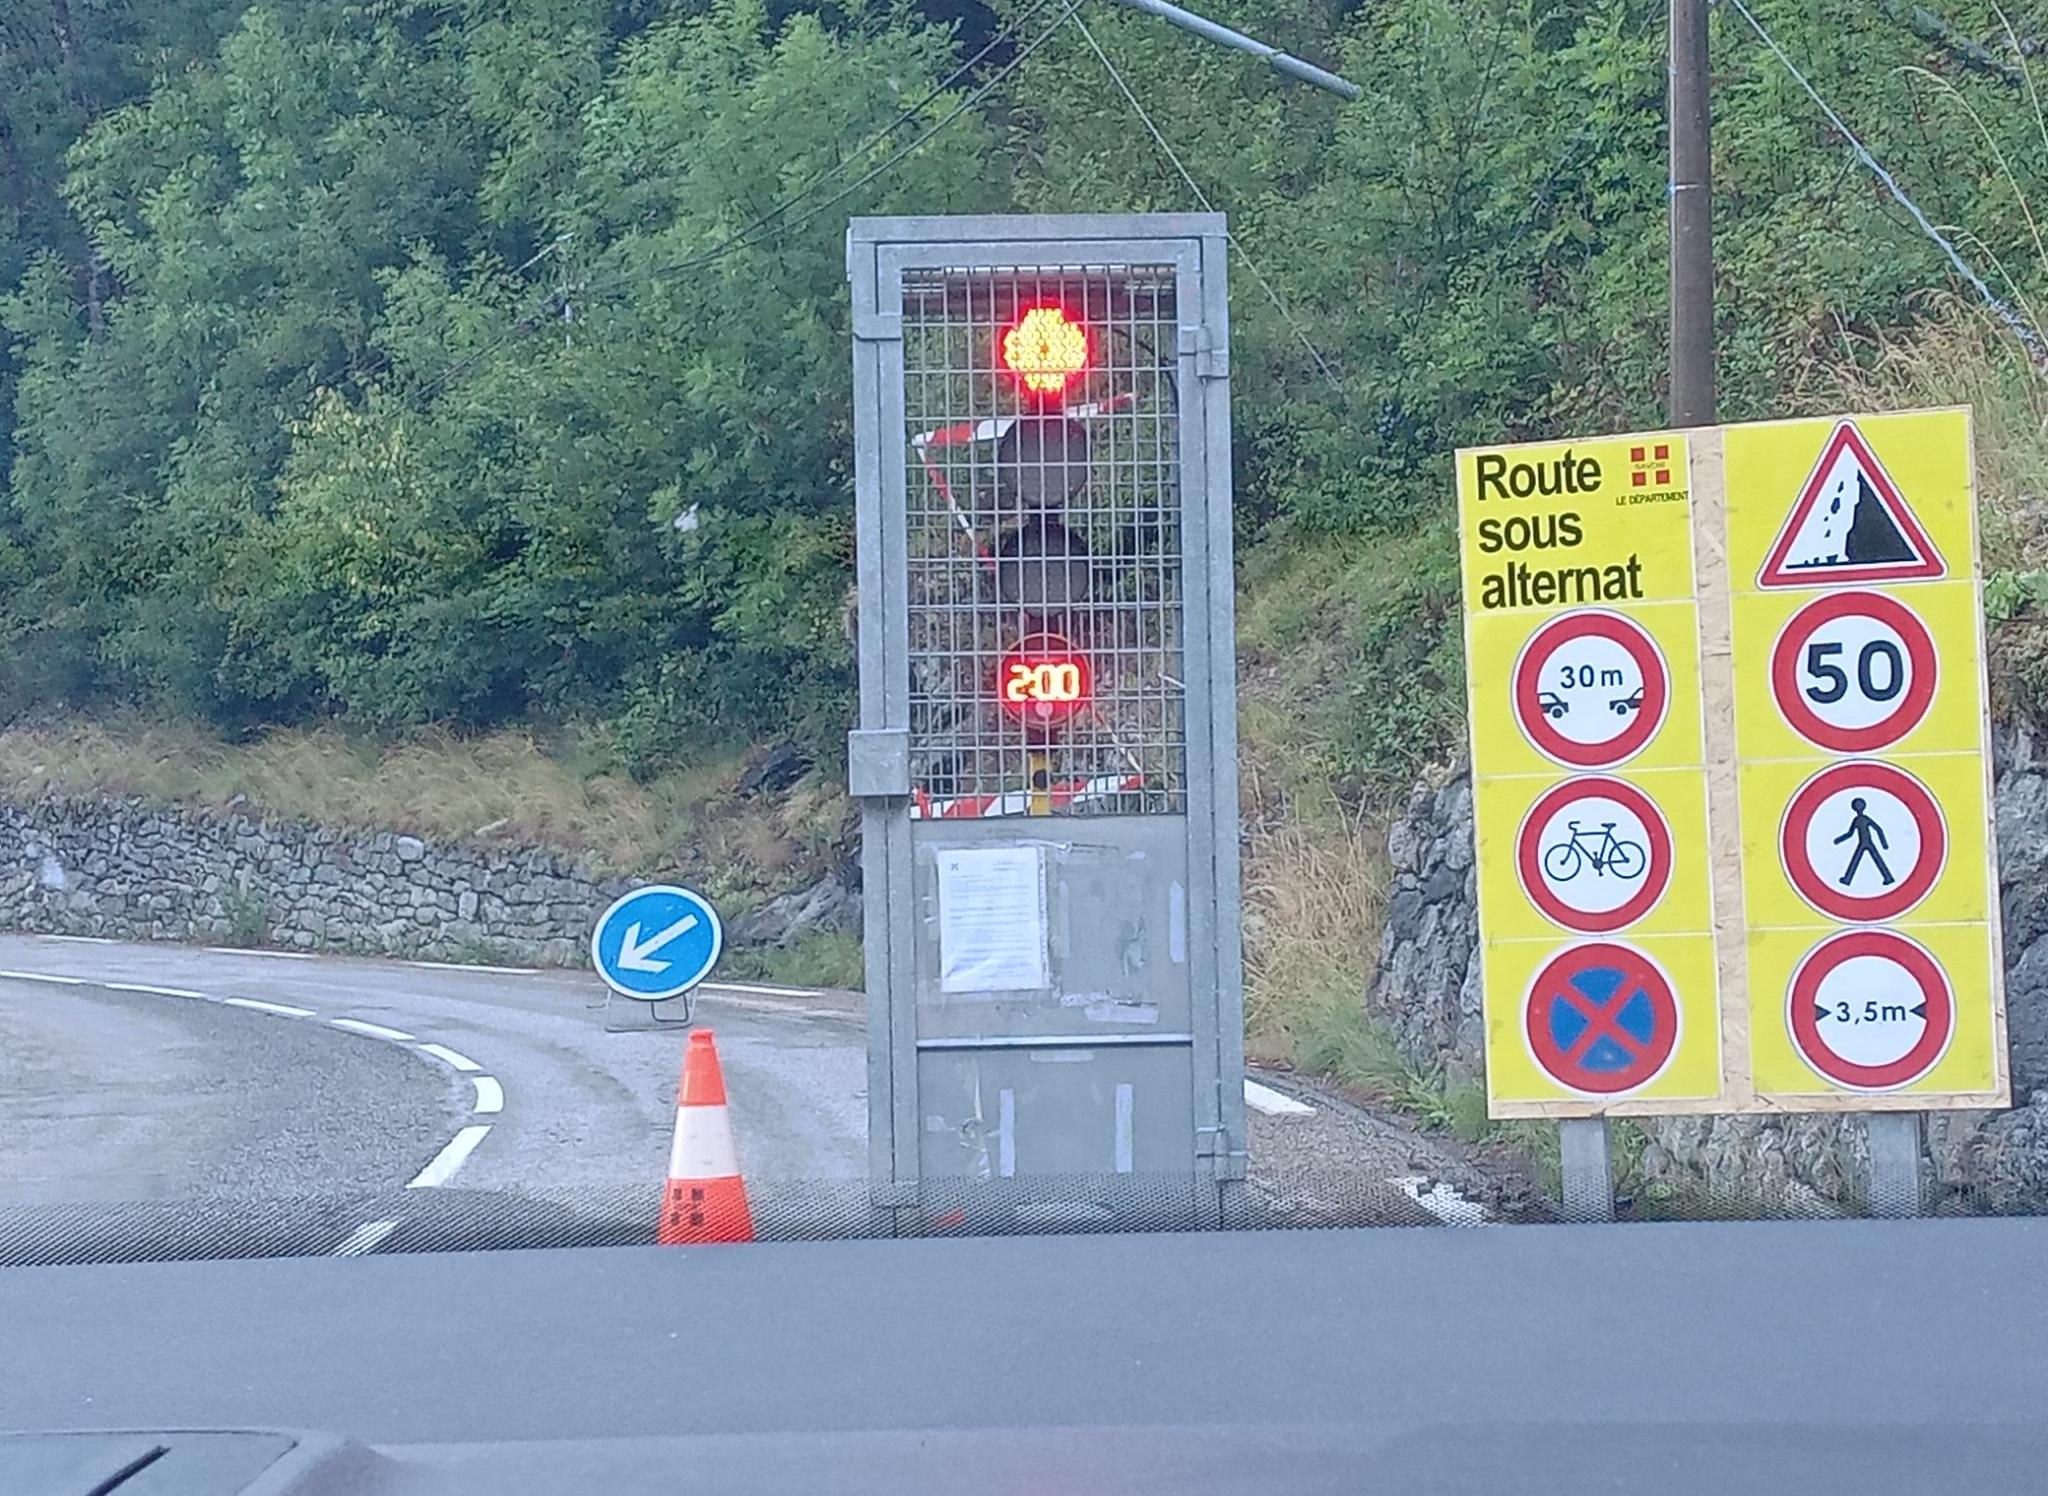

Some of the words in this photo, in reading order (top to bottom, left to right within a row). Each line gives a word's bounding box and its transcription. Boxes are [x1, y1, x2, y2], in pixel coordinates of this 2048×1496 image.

[1476, 449, 1602, 501] Route
[1615, 496, 1627, 506] LE
[1478, 512, 1583, 553] sous
[1481, 553, 1644, 609] alternat
[1806, 640, 1904, 704] 50
[1836, 1001, 1907, 1025] 3,5m
